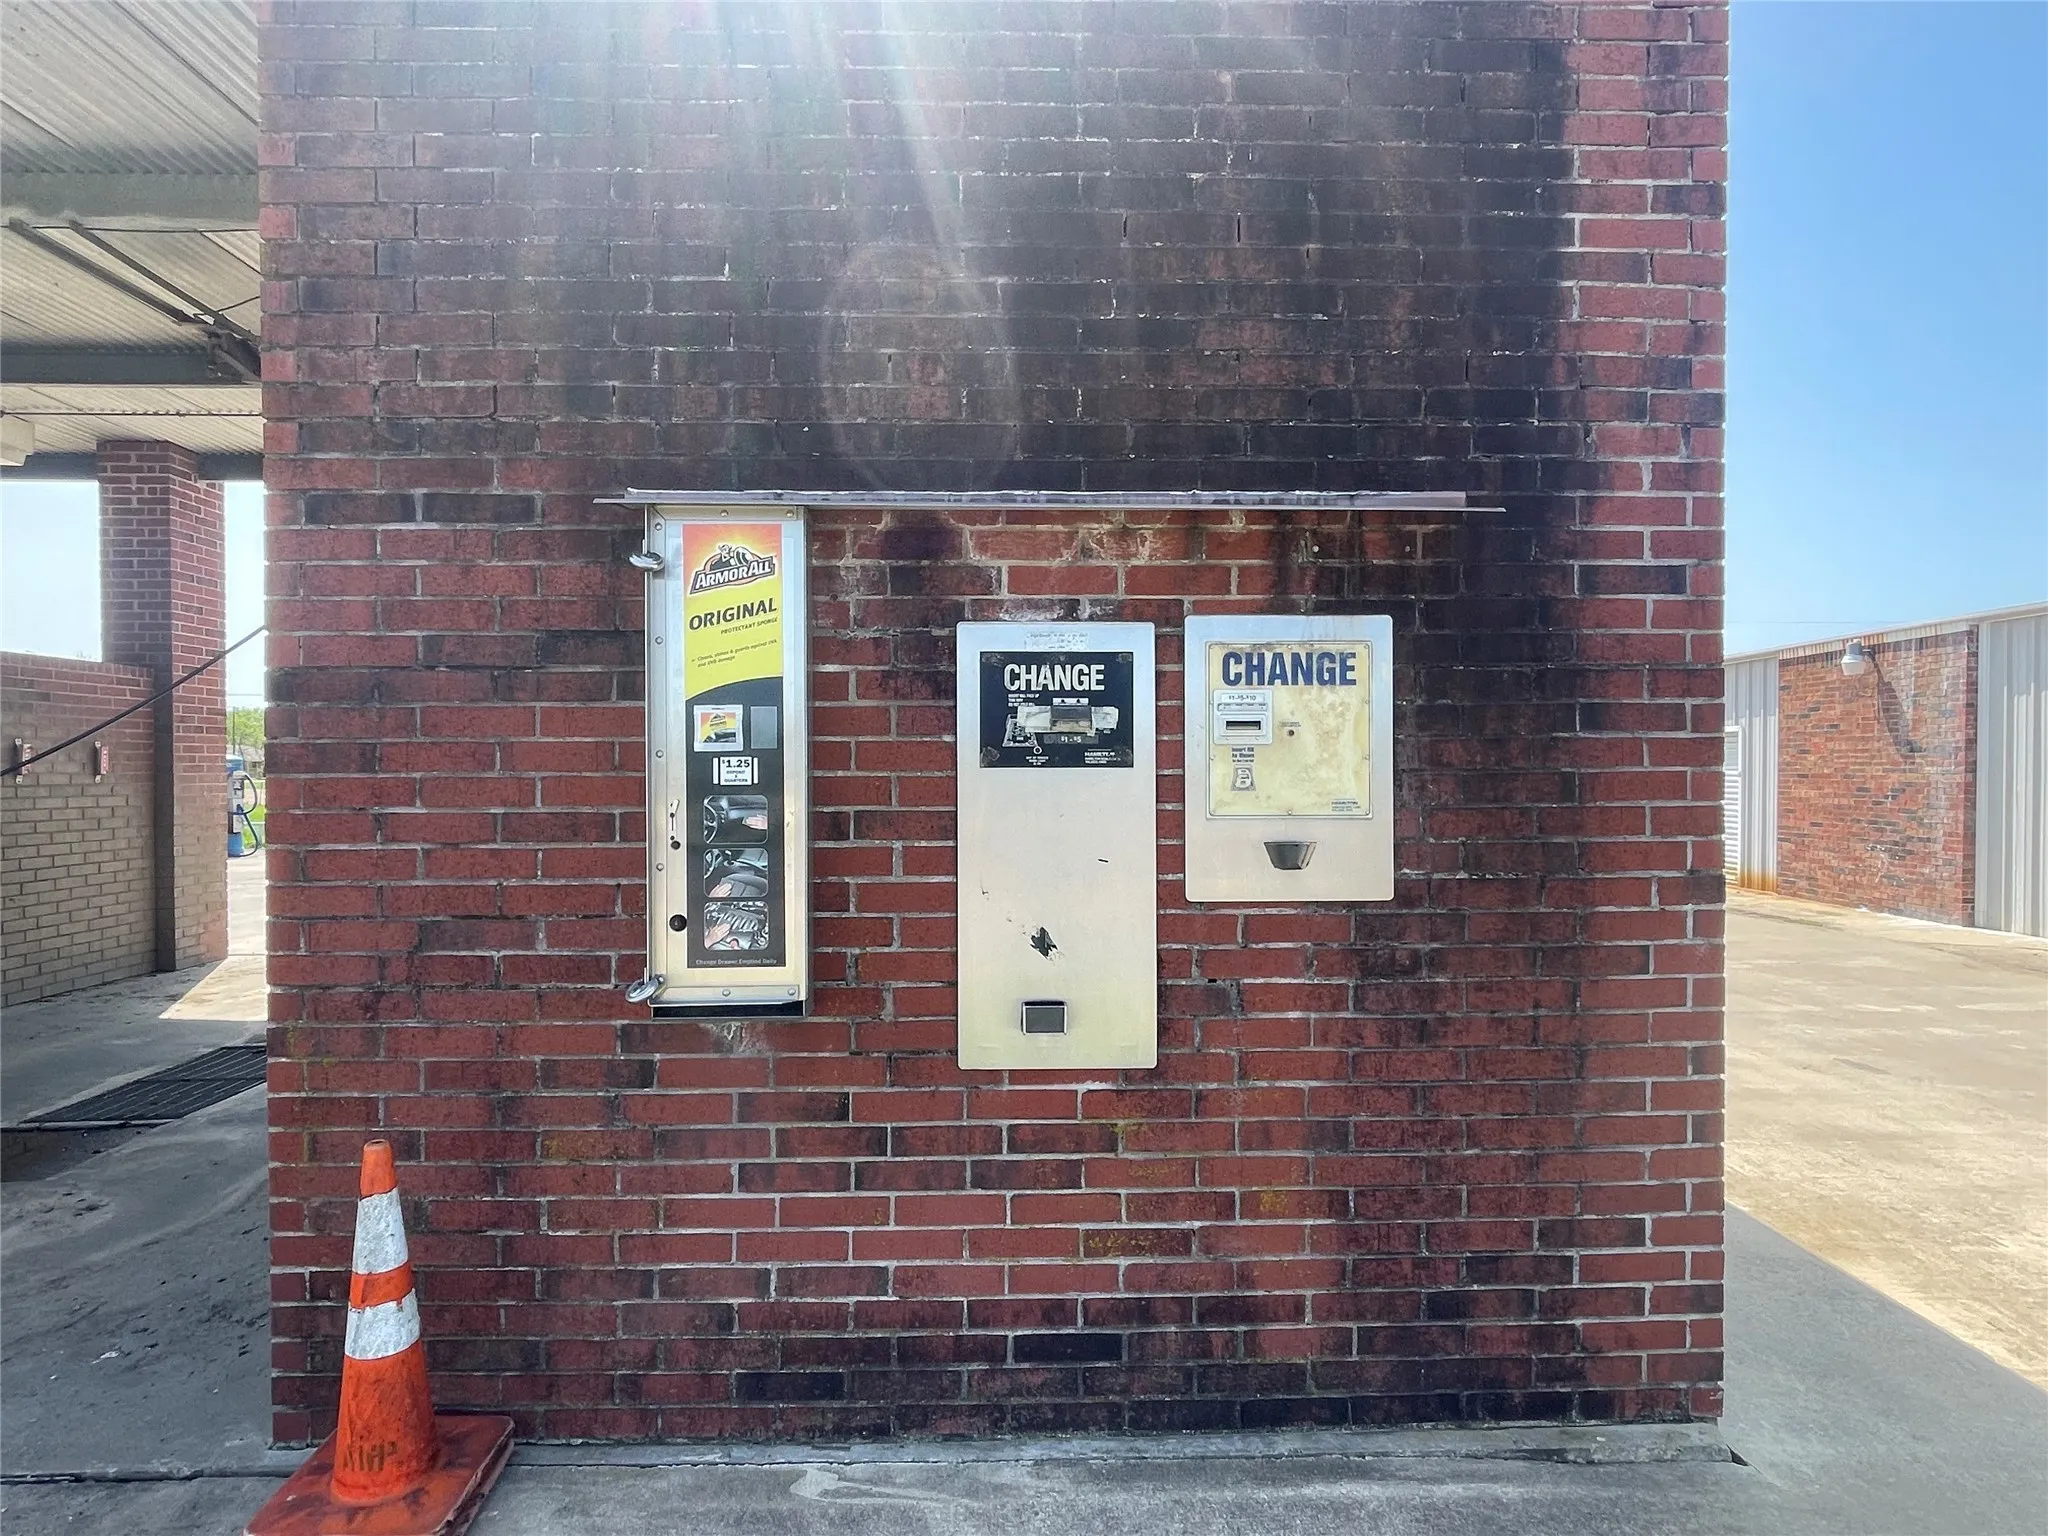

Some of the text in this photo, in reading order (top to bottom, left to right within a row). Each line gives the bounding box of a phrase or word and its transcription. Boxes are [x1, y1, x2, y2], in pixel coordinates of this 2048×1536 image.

[689, 597, 778, 630] ORIGINAL
[1004, 663, 1105, 691] CHANGE
[1222, 652, 1357, 687] CHANGE
[722, 759, 750, 768] $1.25
